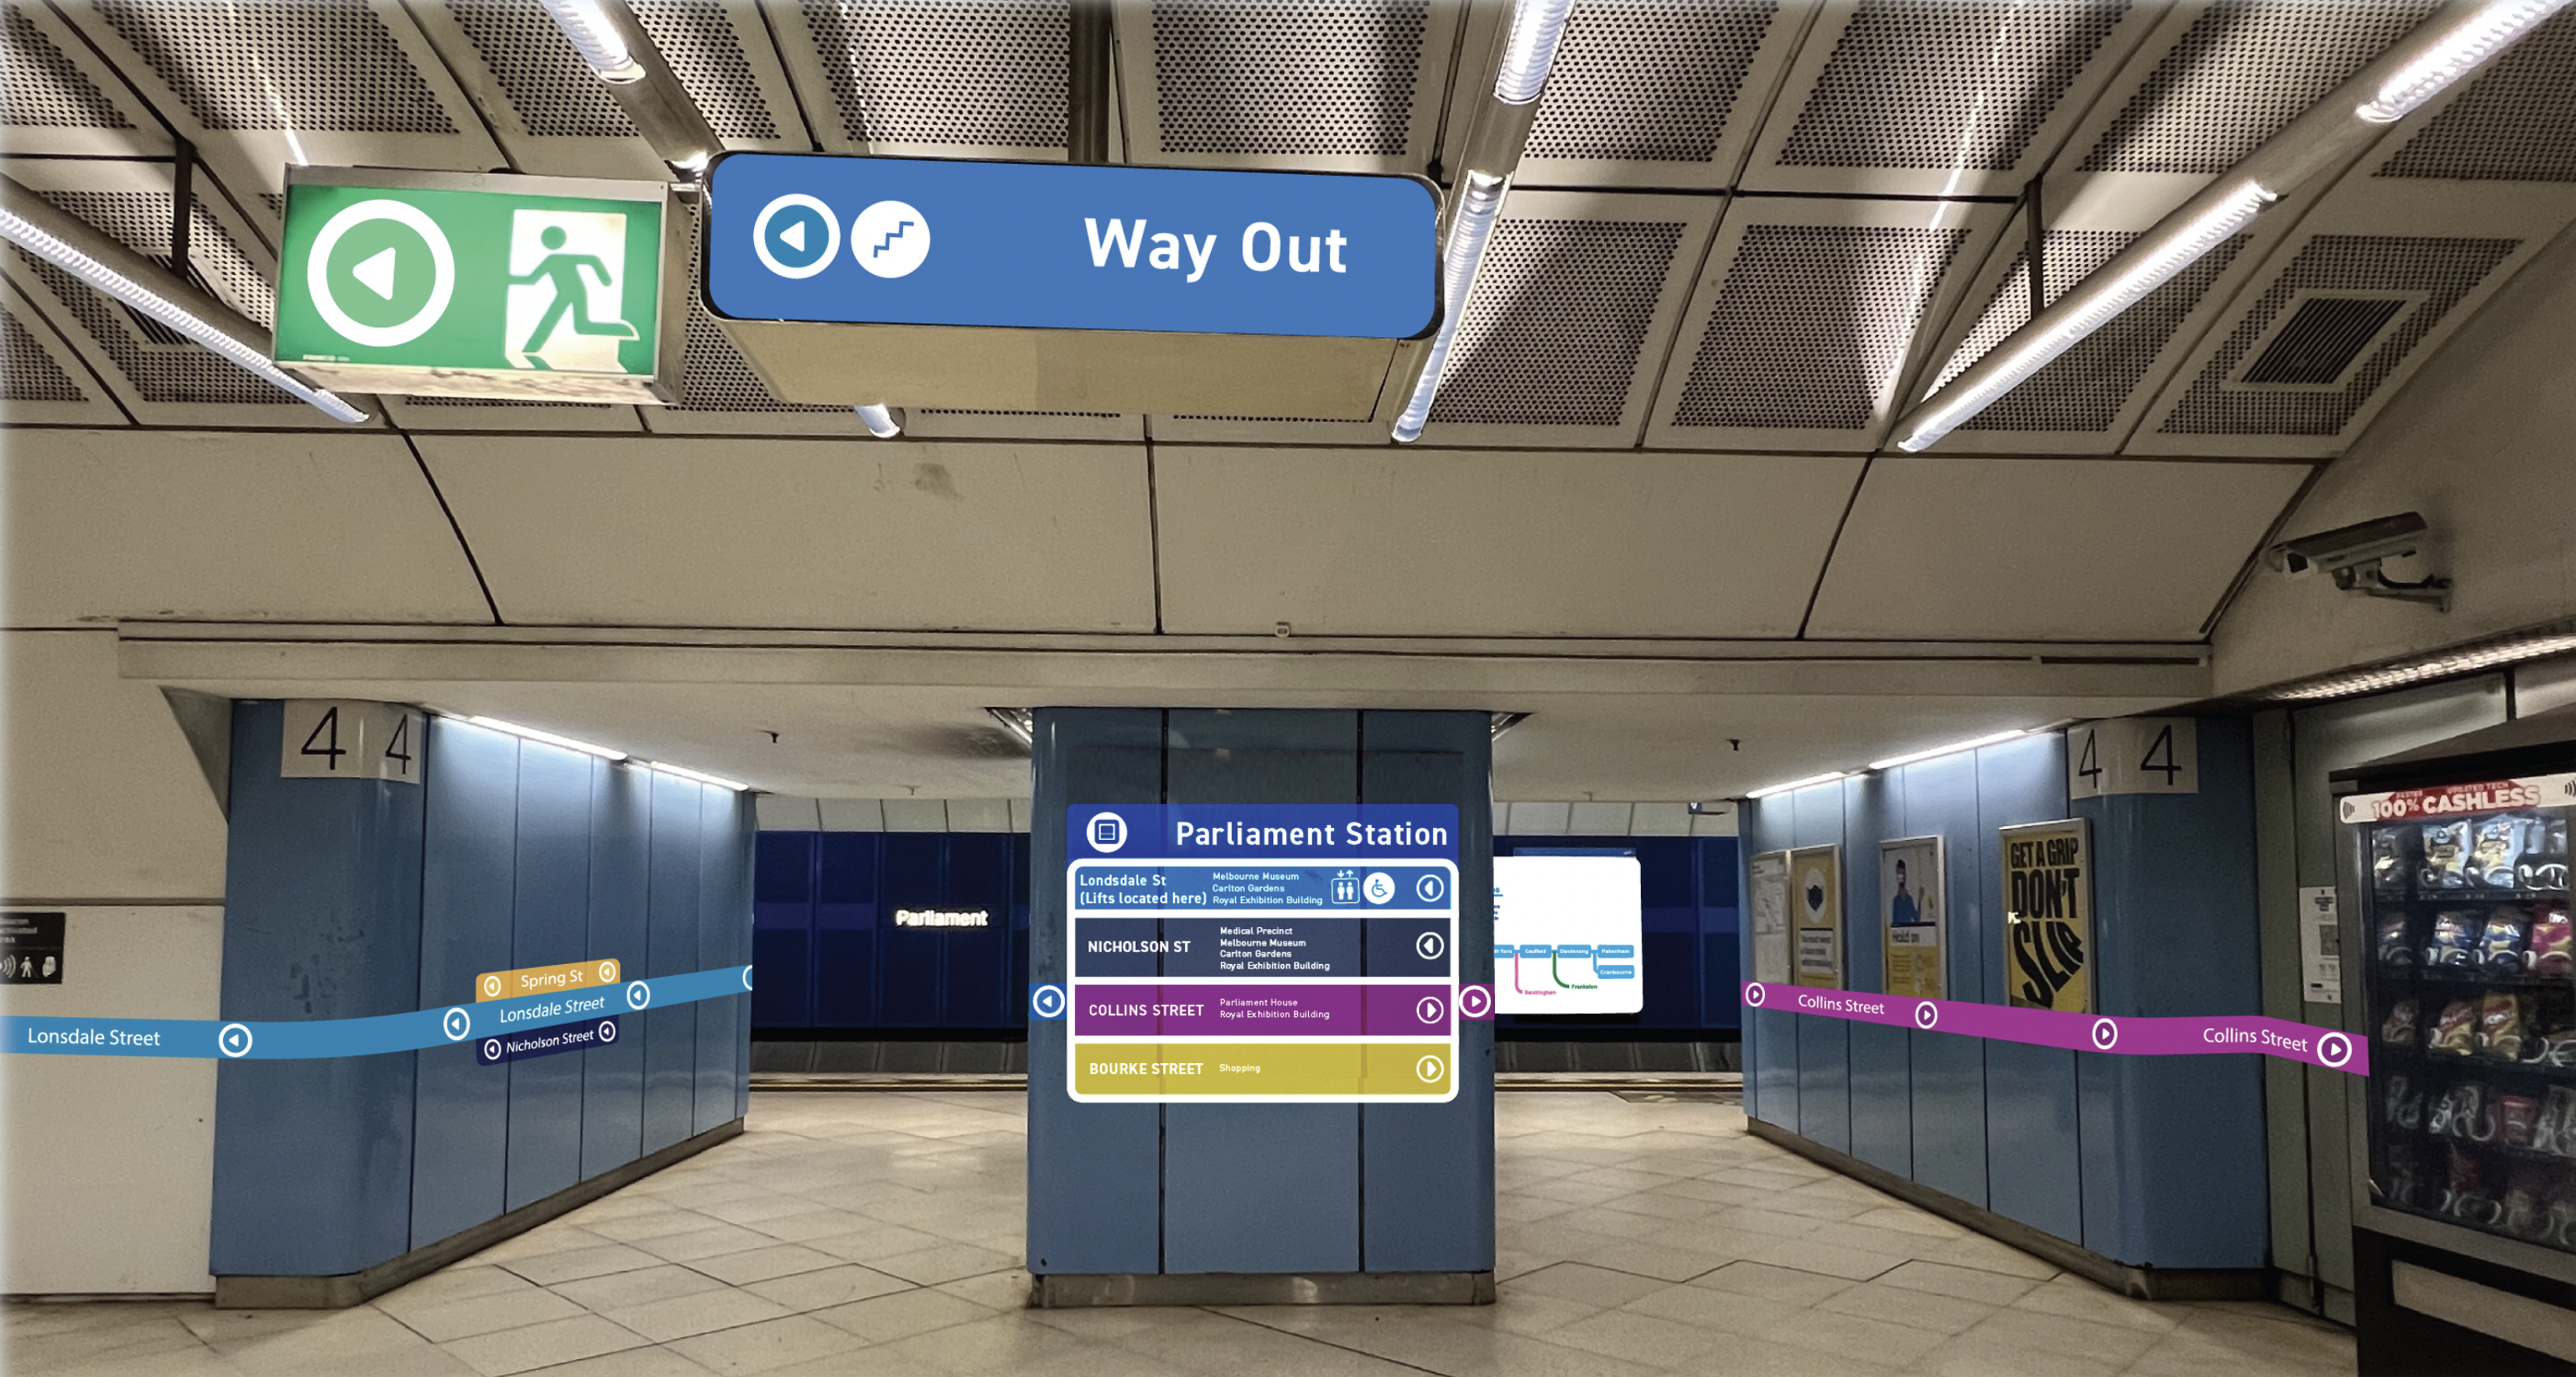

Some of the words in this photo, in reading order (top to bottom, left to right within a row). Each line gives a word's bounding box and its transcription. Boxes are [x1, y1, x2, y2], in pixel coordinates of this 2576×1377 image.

[1084, 218, 1217, 283] Way
[1242, 222, 1347, 273] Out
[301, 706, 347, 770] 4
[385, 713, 412, 775] 4
[2079, 728, 2103, 789] 4
[2140, 724, 2183, 786] 4
[2371, 797, 2420, 818] 100%
[2421, 785, 2542, 814] CASHLESS
[1177, 821, 1335, 845] Parliament
[1347, 821, 1446, 845] Station
[2010, 841, 2034, 869] GET
[2035, 840, 2046, 867] A
[2046, 837, 2080, 866] GRIP
[1080, 874, 1147, 886] Londsdale
[1152, 874, 1166, 886] St
[1213, 872, 1259, 881] Melbourne
[1262, 872, 1299, 881] Museum
[1212, 884, 1245, 892] Carlton
[1247, 884, 1285, 892] Gardens
[2011, 868, 2080, 919] DON'T
[1080, 891, 1115, 906] (Lifts
[1119, 891, 1168, 904] located
[1172, 891, 1207, 906] here)
[1213, 895, 1237, 906] Royal
[1240, 895, 1283, 904] Exhibition
[1286, 895, 1323, 906] Building
[895, 909, 989, 927] Parliament
[1220, 927, 1254, 935] Medical
[1256, 927, 1293, 935] Precinct
[1088, 941, 1169, 953] NICHOLSON
[1173, 941, 1191, 953] ST
[1220, 938, 1267, 947] Melbourne
[1269, 938, 1307, 947] Museum
[1219, 949, 1252, 958] Carlton
[1254, 949, 1292, 958] Gardens
[1220, 961, 1244, 972] Royal
[1247, 961, 1291, 970] Exhibition
[1293, 961, 1330, 972] Building
[2012, 920, 2084, 1009] SLIP
[521, 973, 566, 990] Spring
[569, 970, 584, 983] St
[500, 1002, 561, 1023] Lonsdale
[564, 996, 606, 1014] Street
[1089, 1004, 1147, 1016] COLLINS
[1152, 1004, 1204, 1016] STREET
[1798, 994, 1842, 1011] Collins
[1845, 999, 1885, 1015] Street
[1220, 1010, 1244, 1020] Royal
[1293, 1010, 1330, 1020] Building
[28, 1028, 105, 1045] Lonsdale
[109, 1030, 161, 1047] Street
[506, 1037, 560, 1054] Nicholson
[562, 1030, 595, 1044] Street
[2203, 1027, 2258, 1043] Collins
[2261, 1029, 2308, 1052] Street
[1090, 1062, 1147, 1075] BOURKE
[1151, 1062, 1204, 1075] STREET
[1219, 1063, 1261, 1074] Shopping
